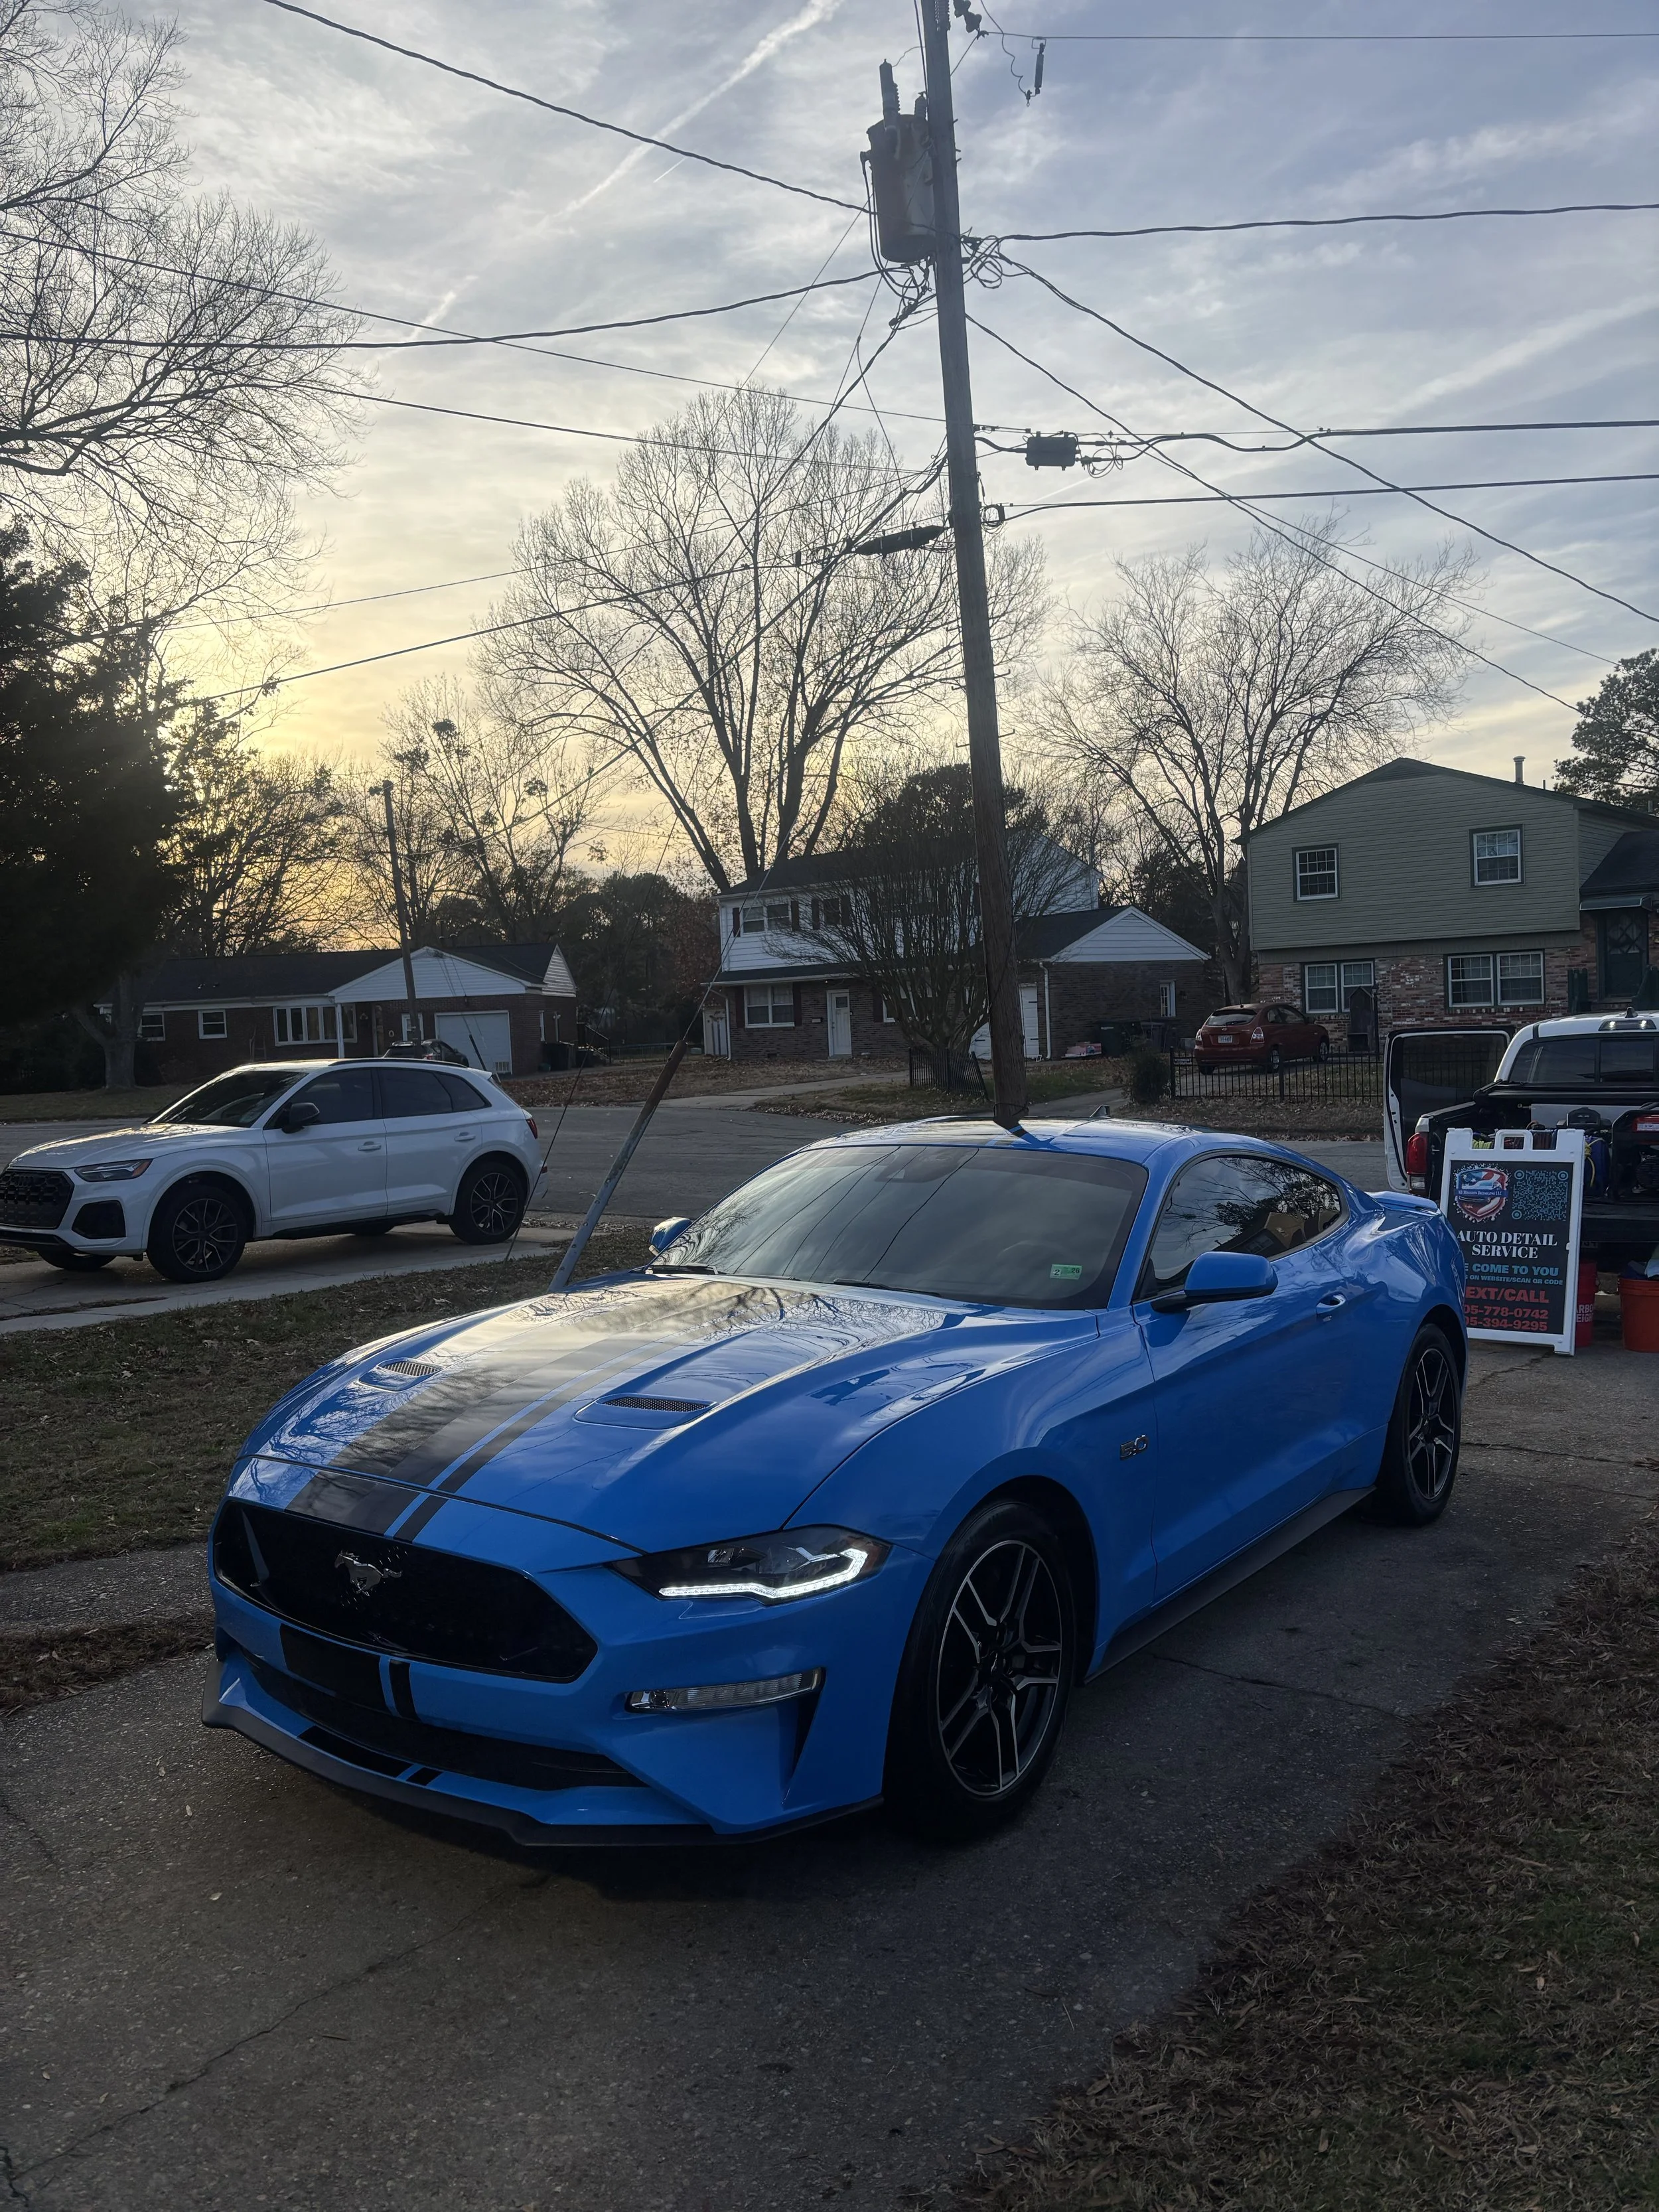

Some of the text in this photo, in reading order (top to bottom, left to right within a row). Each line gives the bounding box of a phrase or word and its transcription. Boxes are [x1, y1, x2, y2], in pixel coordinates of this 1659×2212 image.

[1457, 1230, 1557, 1246] AUTO DETAIL
[1471, 1244, 1538, 1259] SERVICE
[1472, 1263, 1509, 1274] COME
[1512, 1265, 1529, 1275] TO
[1532, 1266, 1559, 1276] YOU
[1480, 1275, 1531, 1284] WEBSITE/SCAN
[1465, 1286, 1550, 1303] EXT/CALL
[1464, 1303, 1549, 1319] 05-778-0742
[1577, 1303, 1593, 1313] RBO
[1465, 1317, 1548, 1331] 05-394-9295
[1577, 1313, 1593, 1323] EIGH
[1119, 1434, 1149, 1461] 5.0
